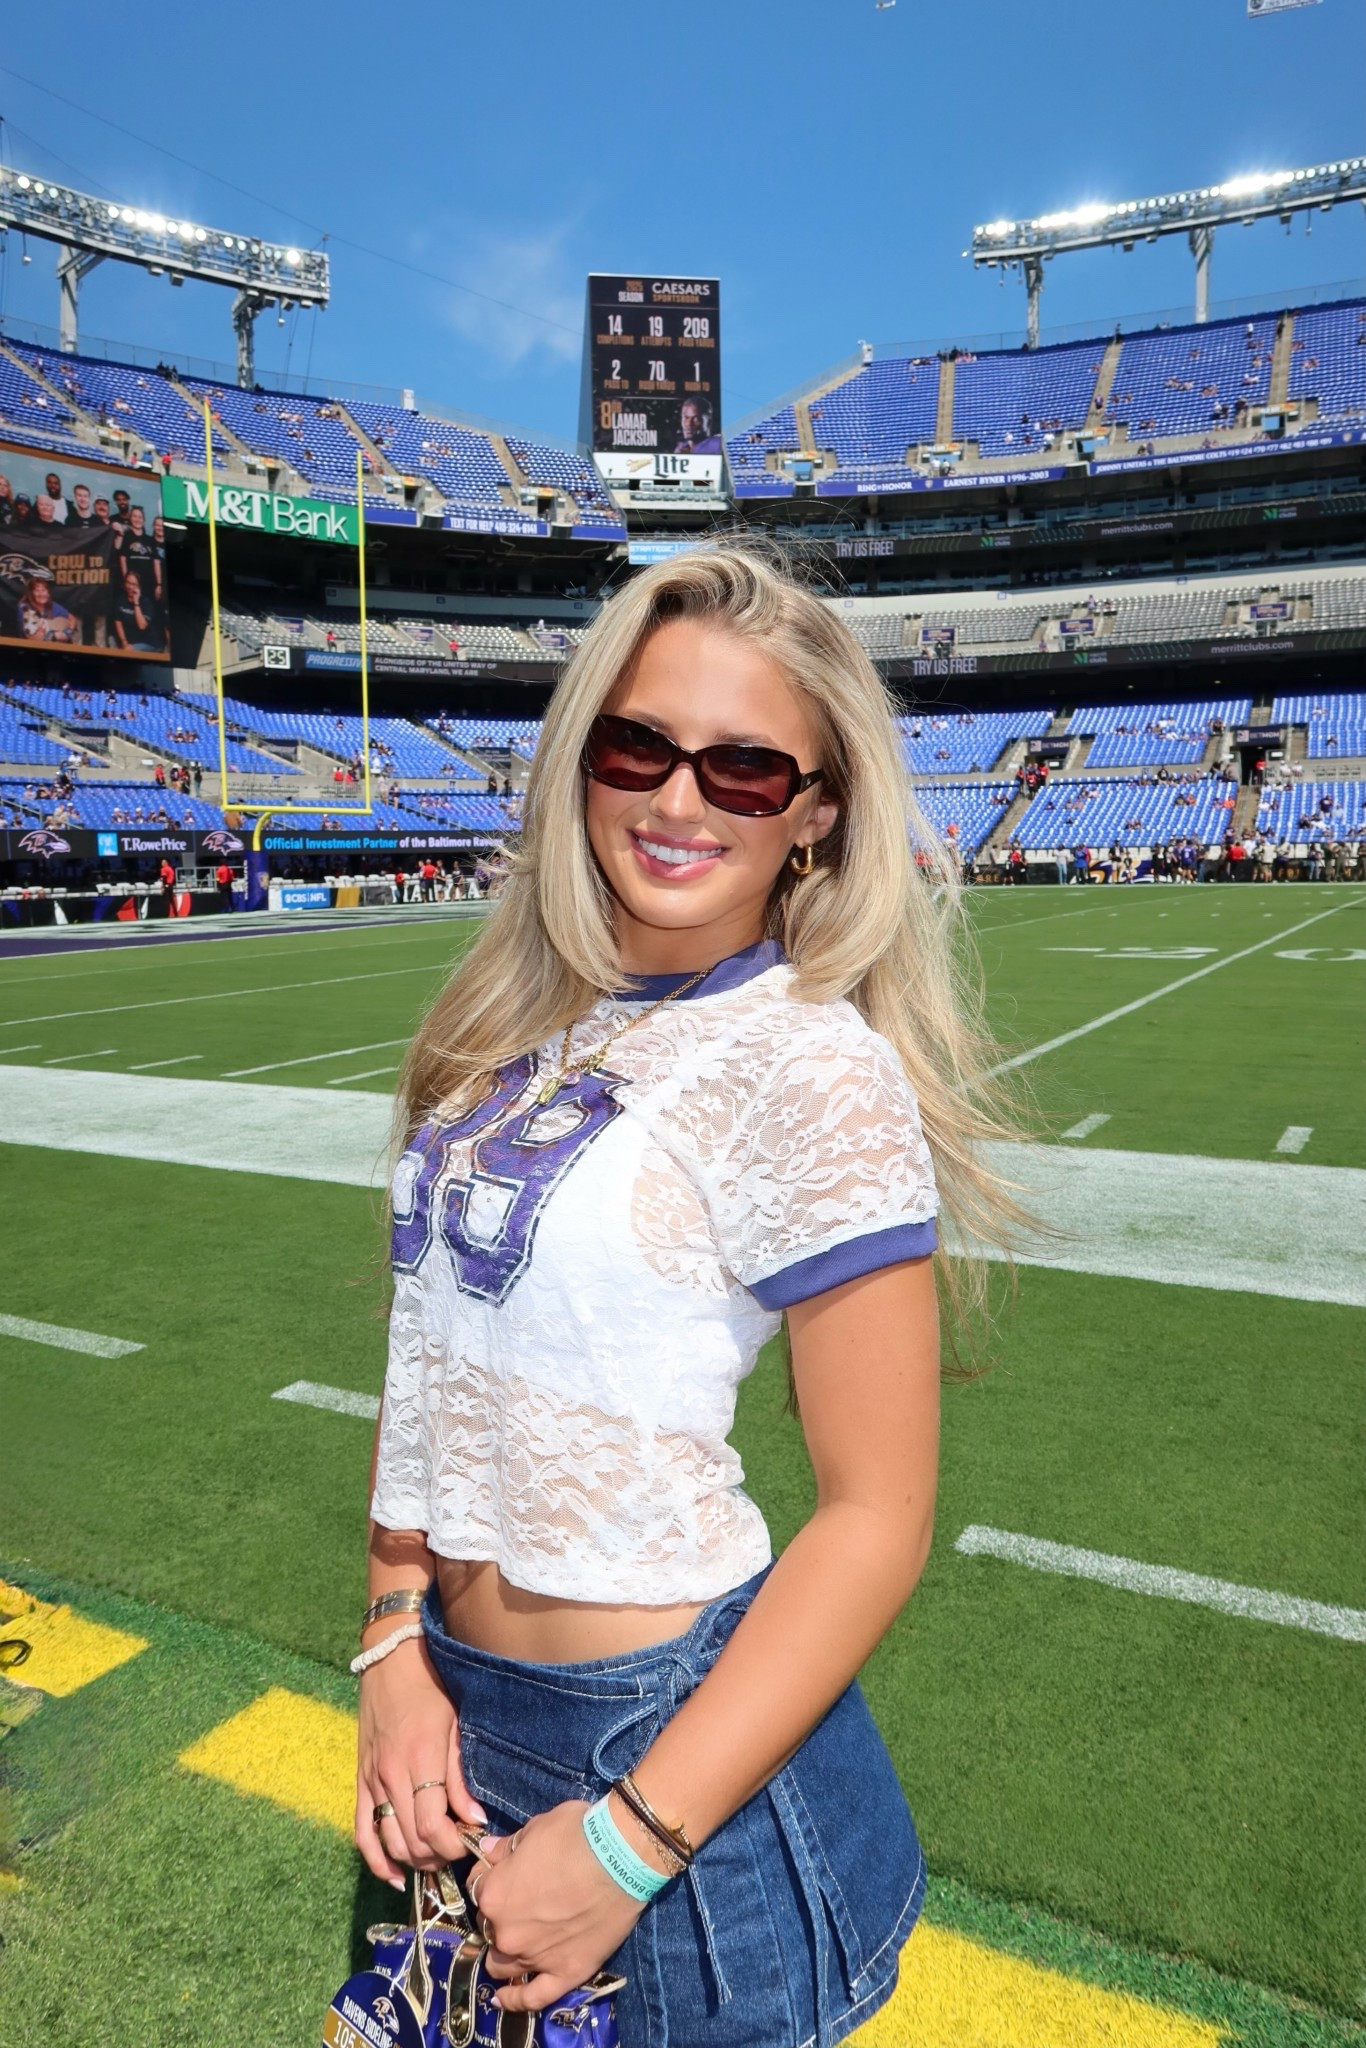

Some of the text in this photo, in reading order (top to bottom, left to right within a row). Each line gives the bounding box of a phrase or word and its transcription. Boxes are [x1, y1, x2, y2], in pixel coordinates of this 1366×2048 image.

[618, 291, 644, 303] SEASON
[652, 283, 710, 296] CAESARS
[608, 315, 709, 338] 14 19 209
[612, 360, 700, 382] 2 70 1
[601, 401, 612, 430] 8
[612, 413, 647, 430] LAMAR
[612, 430, 658, 446] JACKSON
[653, 454, 690, 478] Lite
[1123, 461, 1146, 469] UNITAS
[1153, 458, 1167, 466] THE
[1167, 454, 1205, 464] BALTIMORE
[1206, 451, 1227, 460] COLTS
[944, 470, 1049, 487] EARNEST BYNER 1996-2003
[857, 484, 876, 492] RING
[882, 481, 912, 491] HONOR
[183, 481, 348, 541] M&T Bank
[450, 517, 464, 529] TEXT
[1101, 522, 1173, 535] merrittclubs.com
[836, 541, 894, 557] TRY US FREE!
[49, 554, 85, 569] CAW
[56, 568, 109, 584] ACTION
[1211, 640, 1294, 654] merrittclubs.com
[268, 650, 286, 665] 25
[306, 654, 362, 668] PROGRESSIV
[416, 659, 427, 667] OF
[443, 661, 469, 669] UNITED
[375, 665, 408, 673] CENTRAL
[913, 658, 977, 675] TRY US FREE!
[264, 837, 303, 849] Official
[306, 838, 361, 849] Investment
[363, 837, 398, 849] Partner
[399, 836, 410, 848] of
[411, 837, 426, 848] the
[428, 836, 471, 848] Baltimore
[310, 892, 326, 902] NFL
[600, 1843, 609, 1853] @
[607, 1855, 647, 1894] BROWNS
[424, 1937, 443, 1947] VENS
[341, 1995, 367, 2030] RAVENS
[474, 2030, 497, 2048] AVEN
